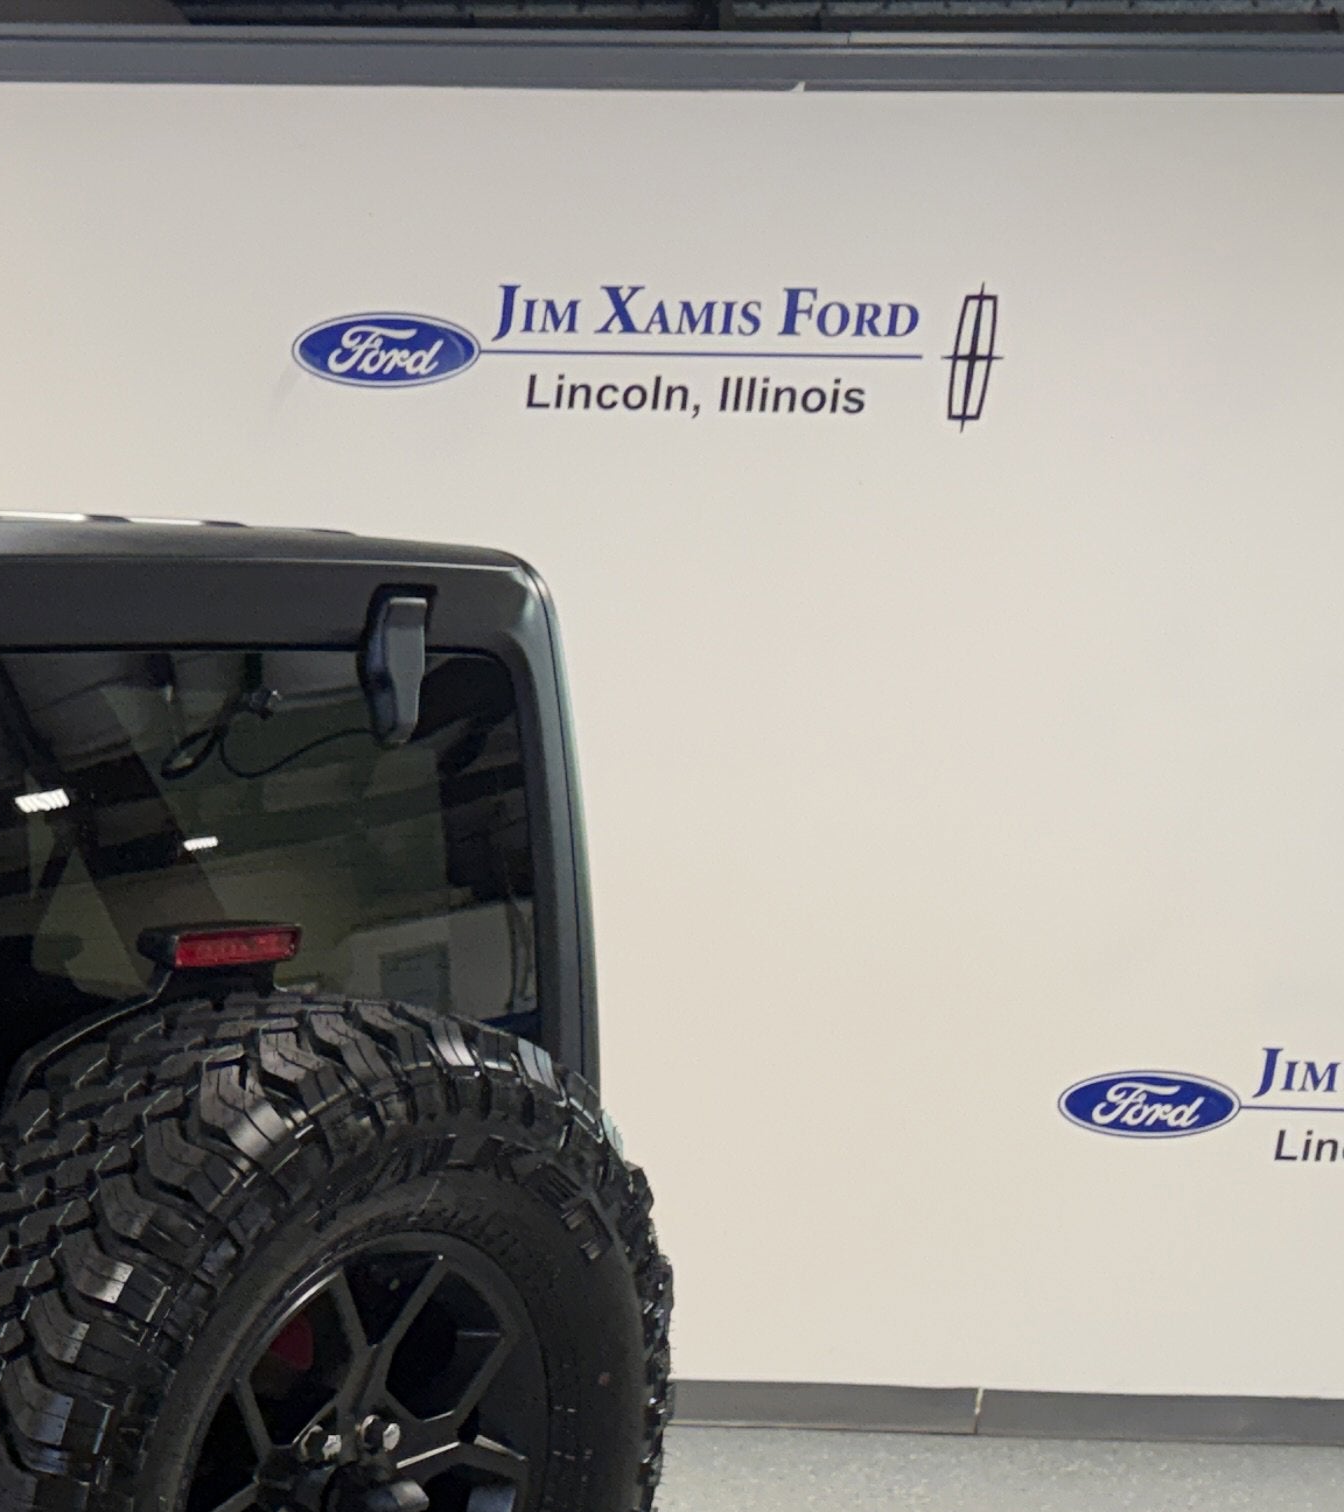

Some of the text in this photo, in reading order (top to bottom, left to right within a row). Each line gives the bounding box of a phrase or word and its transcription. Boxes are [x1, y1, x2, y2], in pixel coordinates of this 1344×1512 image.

[492, 284, 920, 341] JIM XAMIS FORD
[326, 323, 439, 377] Ford
[526, 374, 865, 418] Lincoln, Illinois
[1252, 1047, 1341, 1098] JIM
[1091, 1081, 1206, 1129] Ford
